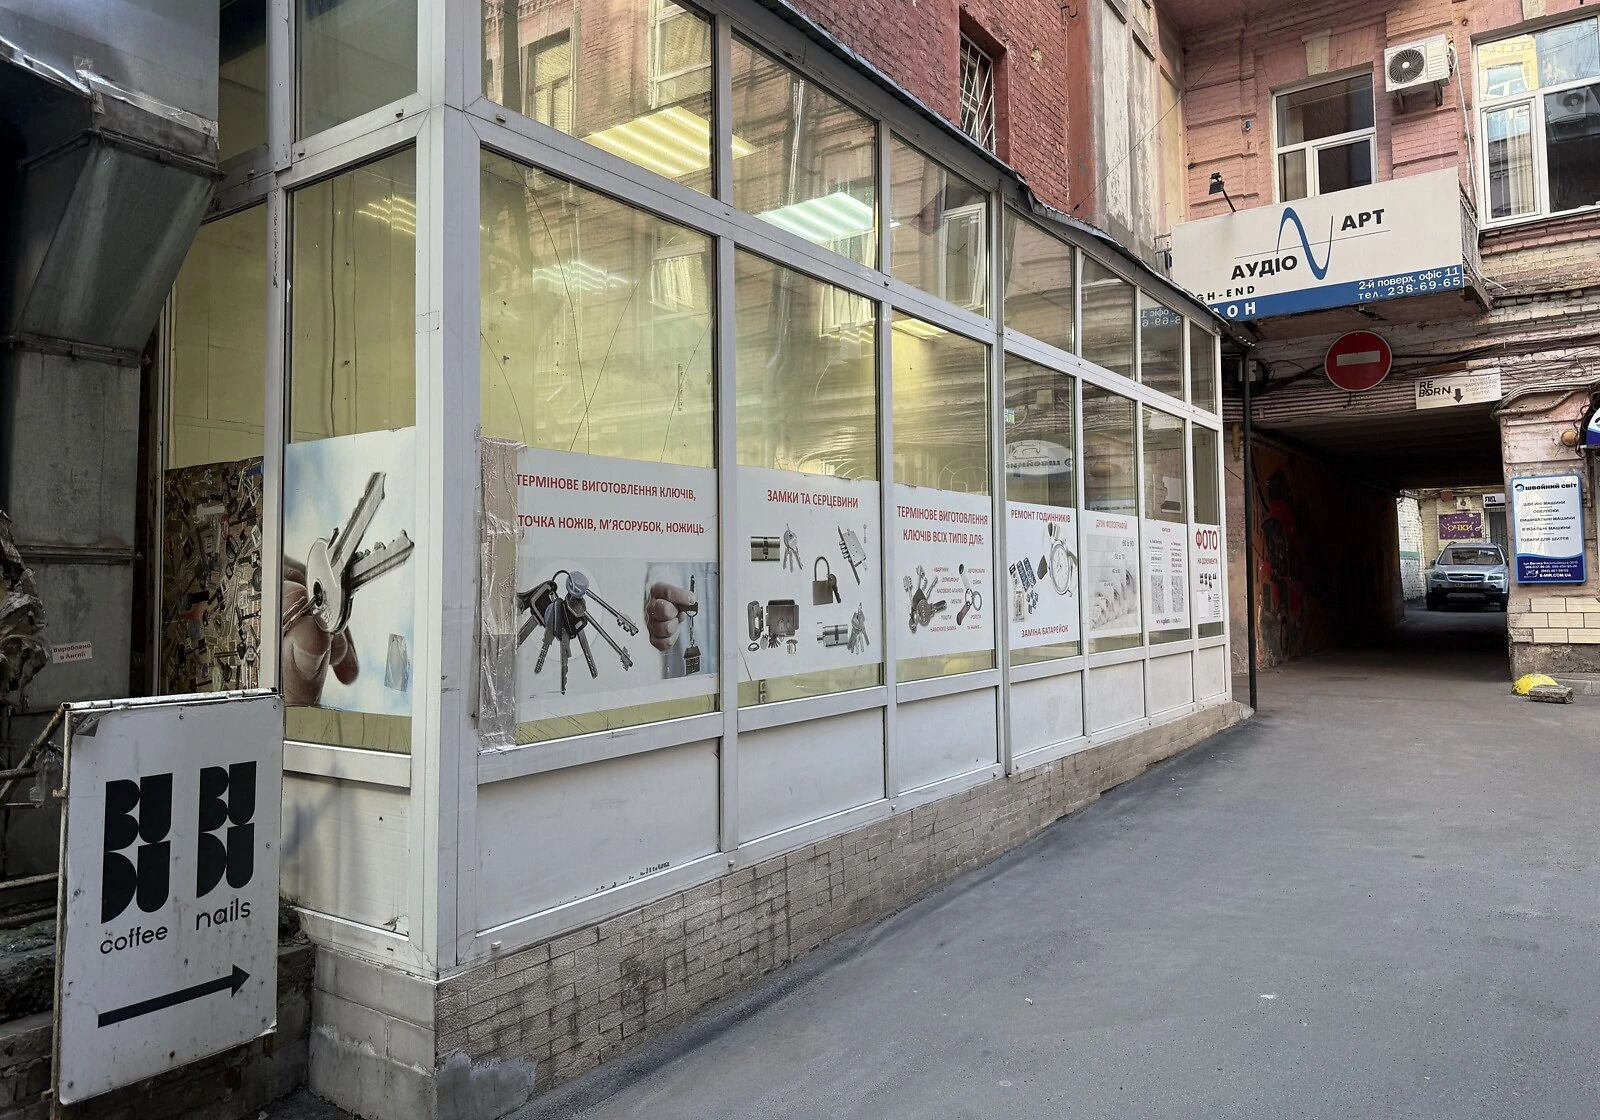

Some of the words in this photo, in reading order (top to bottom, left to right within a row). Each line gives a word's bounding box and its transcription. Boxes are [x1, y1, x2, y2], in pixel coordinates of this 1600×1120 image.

[1340, 208, 1385, 231] АРТ
[1231, 255, 1298, 280] АУДІО
[1358, 279, 1375, 290] 2-й
[1377, 274, 1416, 288] поверх,
[1418, 270, 1442, 281] офіс
[1444, 266, 1460, 277] 11
[1357, 292, 1383, 300] тел.
[1387, 276, 1461, 296] 238-69-65
[1419, 380, 1434, 390] RE
[516, 473, 579, 491] ТЕРМІНОВЕ
[581, 480, 658, 497] ВИГОТОВЛЕННЯ
[659, 488, 697, 501] КЛЮЧІВ,
[767, 489, 799, 504] ЗАМКИ
[800, 492, 811, 505] ТА
[812, 493, 859, 509] СЕРЦЕВИНИ
[558, 517, 597, 531] НОЖІВ,
[599, 518, 664, 534] М’ЯСОРУБОК,
[666, 523, 705, 536] НОЖИЦЬ
[896, 505, 938, 520] ТЕРМІНОВЕ
[938, 510, 988, 525] ВИГОТОВЛЕННЯ
[1010, 509, 1035, 520] РЕМОНТ
[1036, 512, 1071, 523] ГОДИННИКІВ
[903, 528, 932, 541] КЛЮЧІВ
[932, 531, 948, 543] ВСІХ
[949, 532, 968, 544] ТИПІВ
[968, 533, 984, 546] ДЛЯ:
[1195, 528, 1218, 551] ФОТО
[1021, 628, 1042, 638] ЗАМІНА
[1042, 623, 1069, 635] БАТАРЕЙОК
[195, 898, 251, 931] nails
[100, 926, 169, 955] coffee
